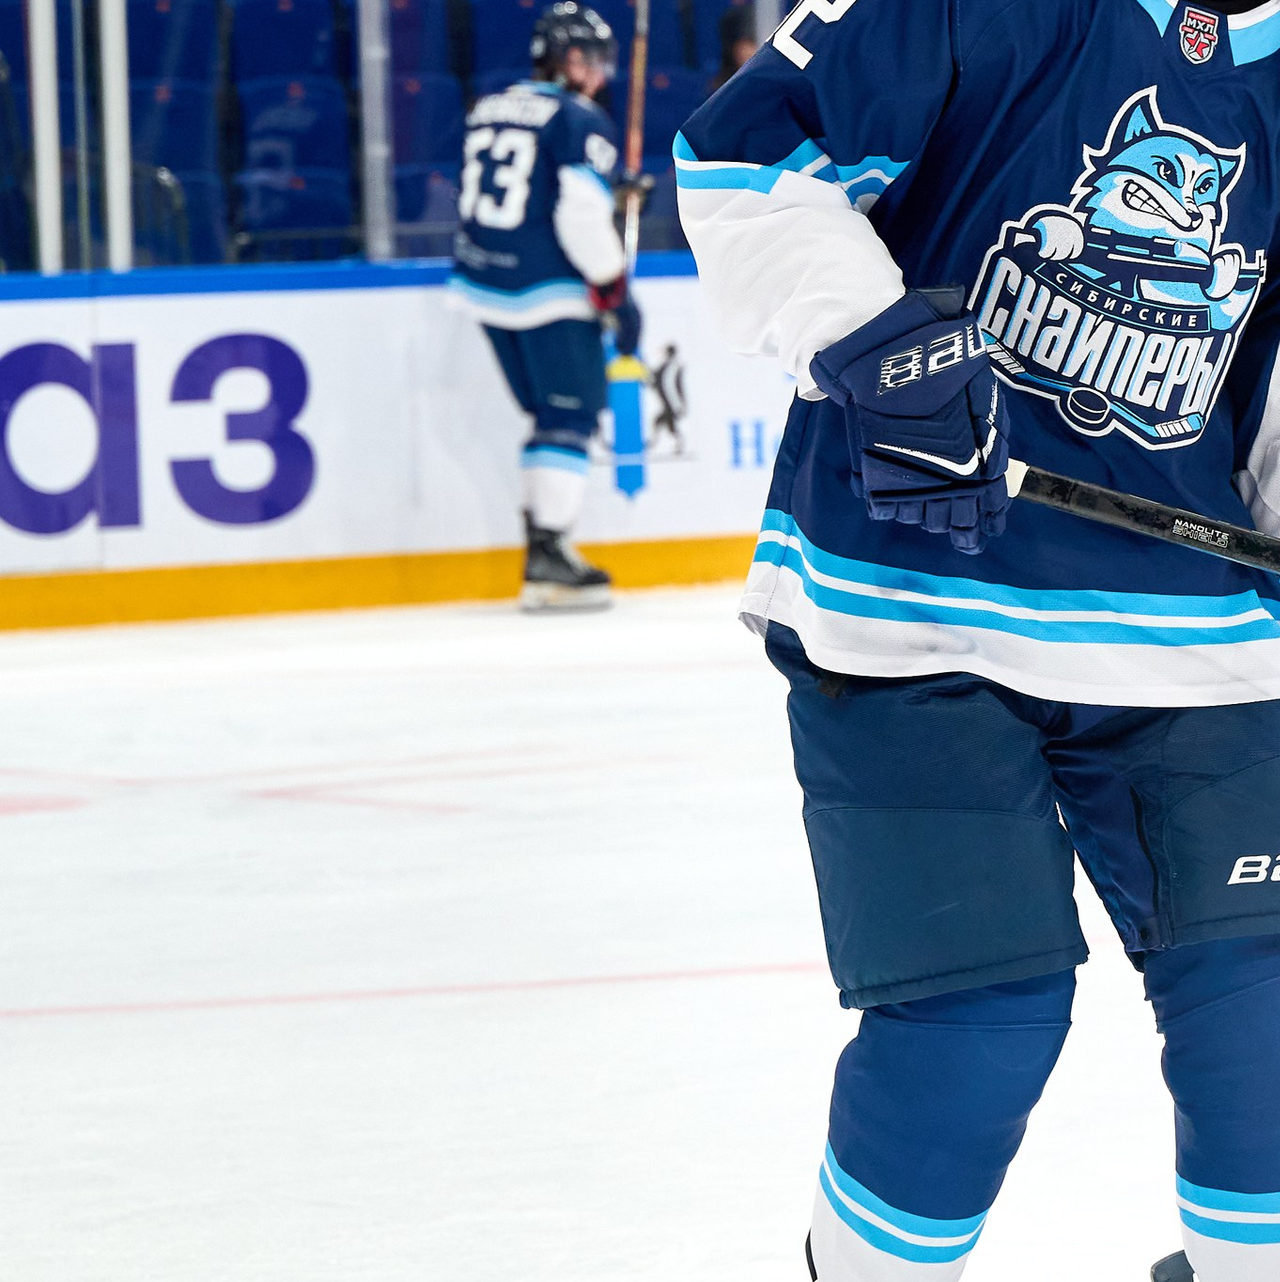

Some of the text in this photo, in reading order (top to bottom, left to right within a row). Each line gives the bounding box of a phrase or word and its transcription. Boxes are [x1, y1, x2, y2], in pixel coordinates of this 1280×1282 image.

[1186, 17, 1215, 35] МХЛ
[1056, 272, 1199, 327] СИБИРСКИЕ
[979, 255, 1232, 416] СНАЙПЕРЫ
[1172, 524, 1229, 549] SHIELD
[1174, 518, 1230, 540] NANOLITE
